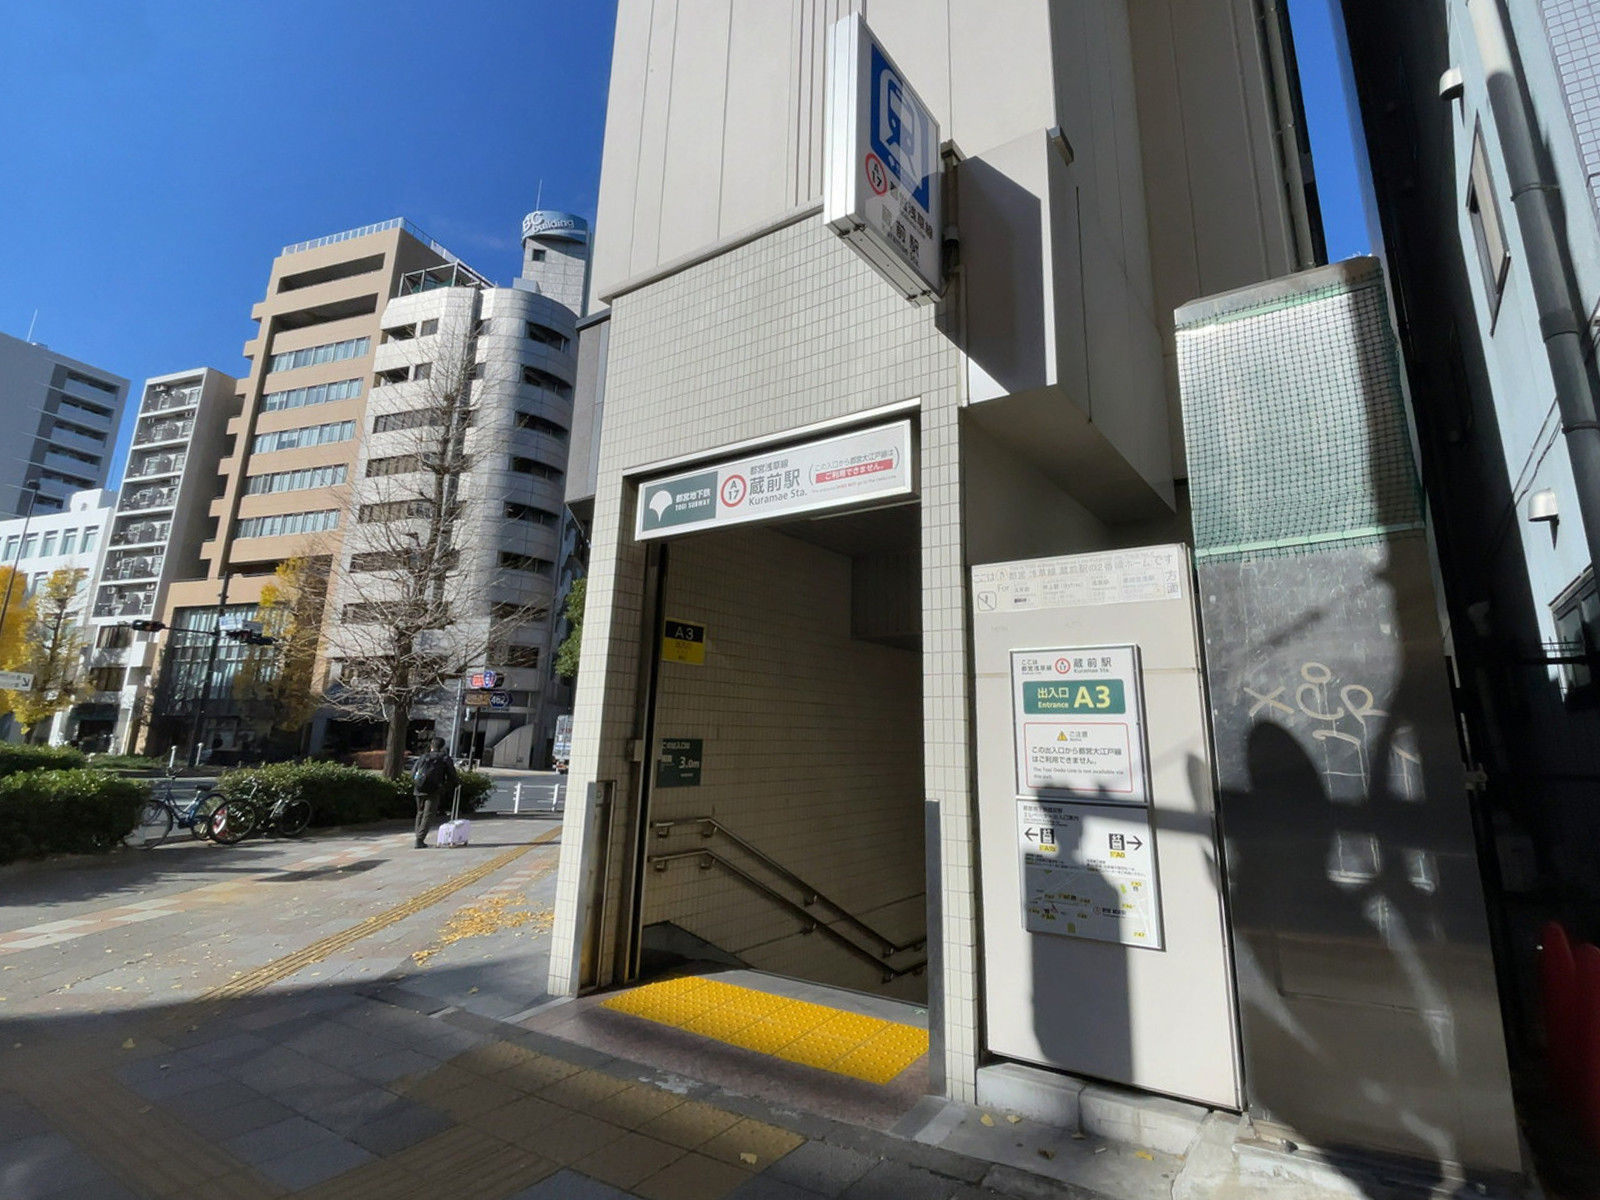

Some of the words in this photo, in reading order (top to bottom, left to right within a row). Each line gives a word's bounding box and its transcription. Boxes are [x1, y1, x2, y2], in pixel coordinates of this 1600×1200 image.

[523, 211, 543, 232] BC
[750, 459, 789, 475] 都営浅草線
[731, 480, 738, 489] A
[750, 468, 801, 495] 蔵前駅
[728, 490, 740, 500] 17
[749, 491, 788, 506] Kuramae
[790, 488, 807, 499] Sta.
[674, 626, 694, 641] A3
[1073, 657, 1112, 668] 蔵前駅
[1037, 687, 1069, 699] 出入口
[1073, 685, 1111, 708] A3
[678, 755, 700, 769] 3.0m
